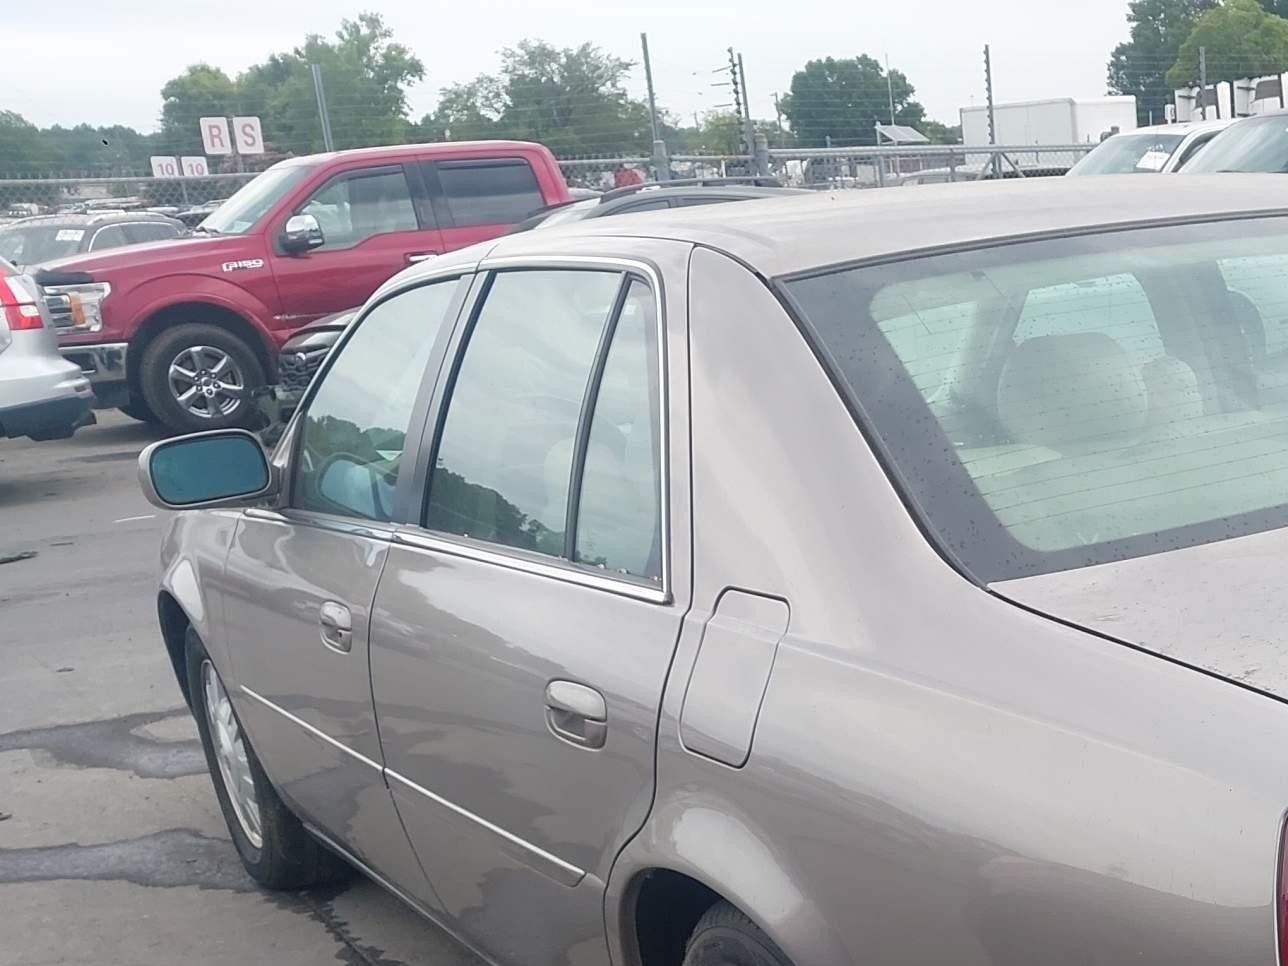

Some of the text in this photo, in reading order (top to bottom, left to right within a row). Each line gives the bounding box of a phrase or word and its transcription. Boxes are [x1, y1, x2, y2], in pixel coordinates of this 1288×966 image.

[207, 124, 225, 149] R
[241, 123, 256, 148] S
[158, 163, 175, 177] 10
[188, 163, 205, 177] 10
